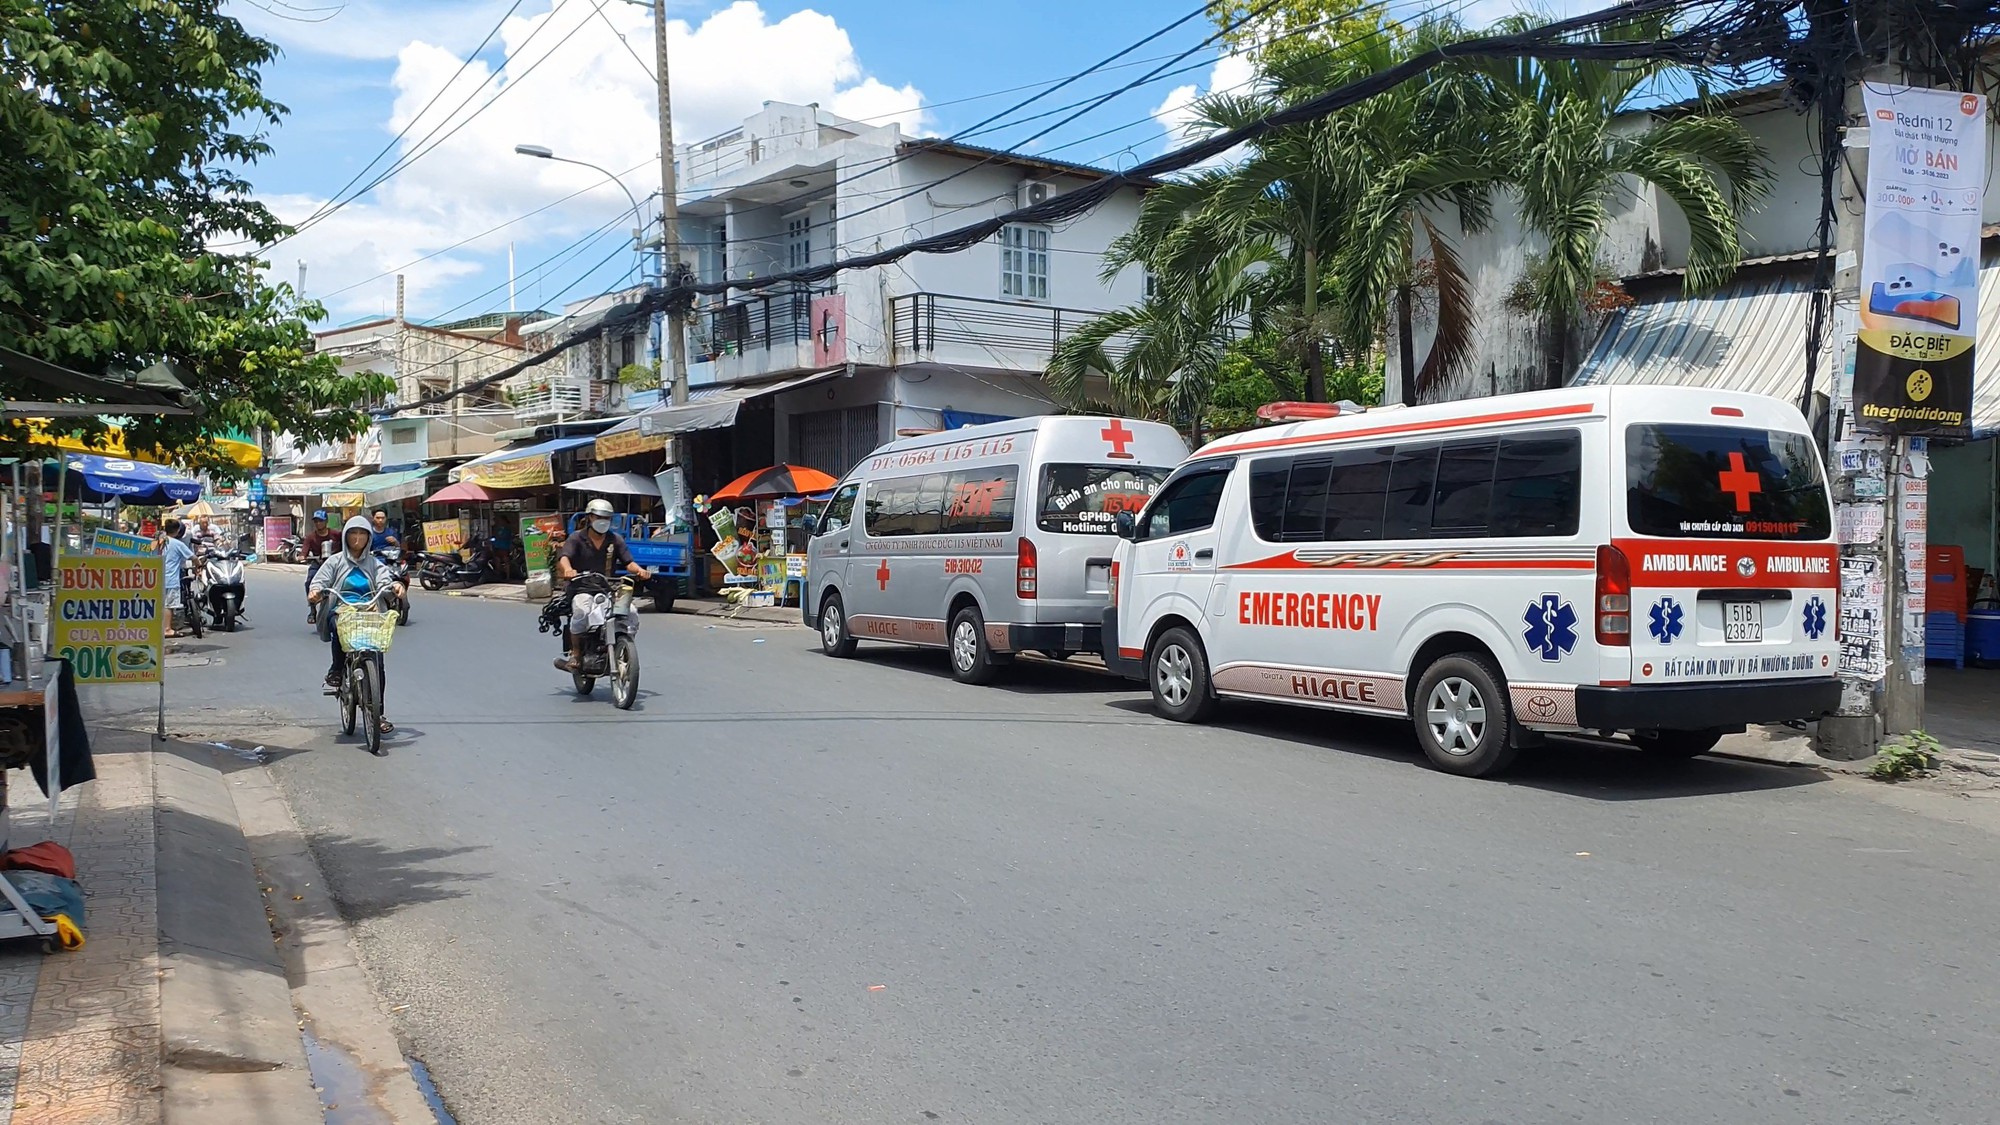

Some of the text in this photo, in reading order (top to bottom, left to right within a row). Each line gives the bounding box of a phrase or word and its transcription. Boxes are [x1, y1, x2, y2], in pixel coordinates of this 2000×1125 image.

[1896, 112, 1953, 132] Redmi 12
[1895, 144, 1959, 171] MỞ BÁN
[1890, 332, 1952, 355] ĐẶC BIỆT
[1862, 403, 1963, 426] thegioididong
[871, 437, 1015, 472] ĐT: 0564 115 115
[1055, 489, 1082, 511] Bình
[1083, 482, 1098, 496] an
[1100, 478, 1121, 491] cho
[1062, 522, 1107, 532] Hotline:
[966, 537, 984, 551] VIỆT
[985, 538, 1003, 549] NAM
[1643, 554, 1727, 572] AMBULANCE
[1767, 556, 1830, 573] AMBULANCE
[1849, 560, 1873, 572] VAY
[62, 563, 158, 590] BÚN RIÊU
[63, 594, 156, 620] CANH BÚN
[1239, 592, 1382, 631] EMERGENCY
[1733, 604, 1753, 622] 51B
[69, 623, 148, 642] CUA ĐỒNG
[867, 620, 935, 636] HIACE TOYOTA
[1726, 622, 1761, 640] 238.72
[60, 645, 114, 679] 30K
[1664, 656, 1682, 677] RẤT
[1684, 656, 1704, 676] CẢM
[1719, 656, 1735, 677] QUÝ
[1738, 658, 1746, 677] VỊ
[1260, 672, 1377, 703] TOYOTA HIACE
